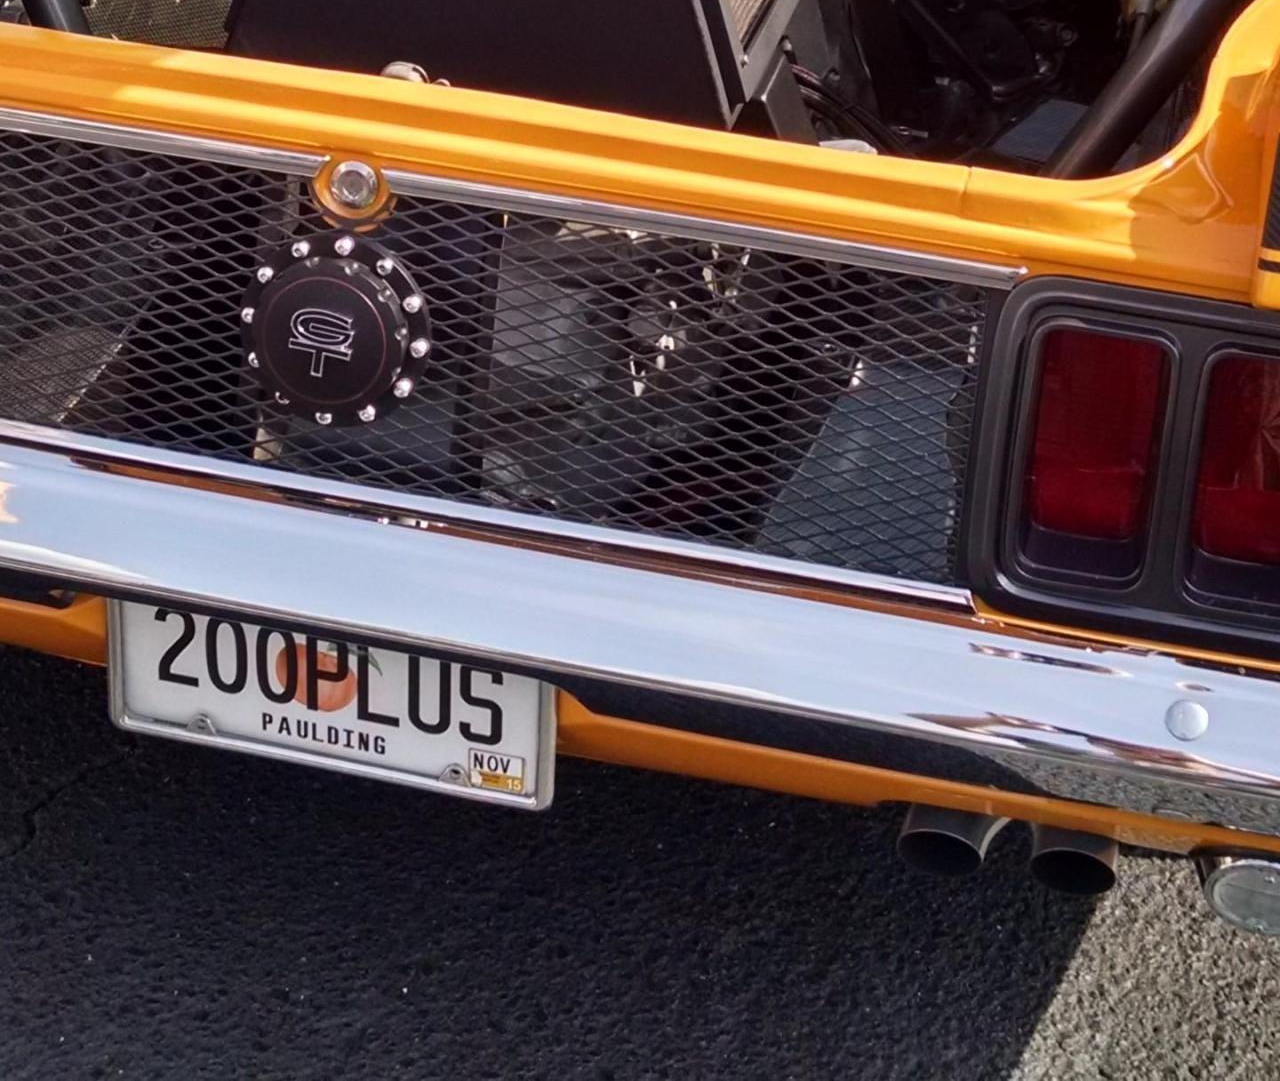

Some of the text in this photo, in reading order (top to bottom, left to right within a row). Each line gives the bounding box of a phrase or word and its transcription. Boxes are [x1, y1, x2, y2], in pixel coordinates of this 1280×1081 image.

[153, 606, 505, 747] 200PLUS
[261, 711, 387, 756] PAULDING
[473, 751, 511, 774] NOV
[506, 778, 522, 791] 15
